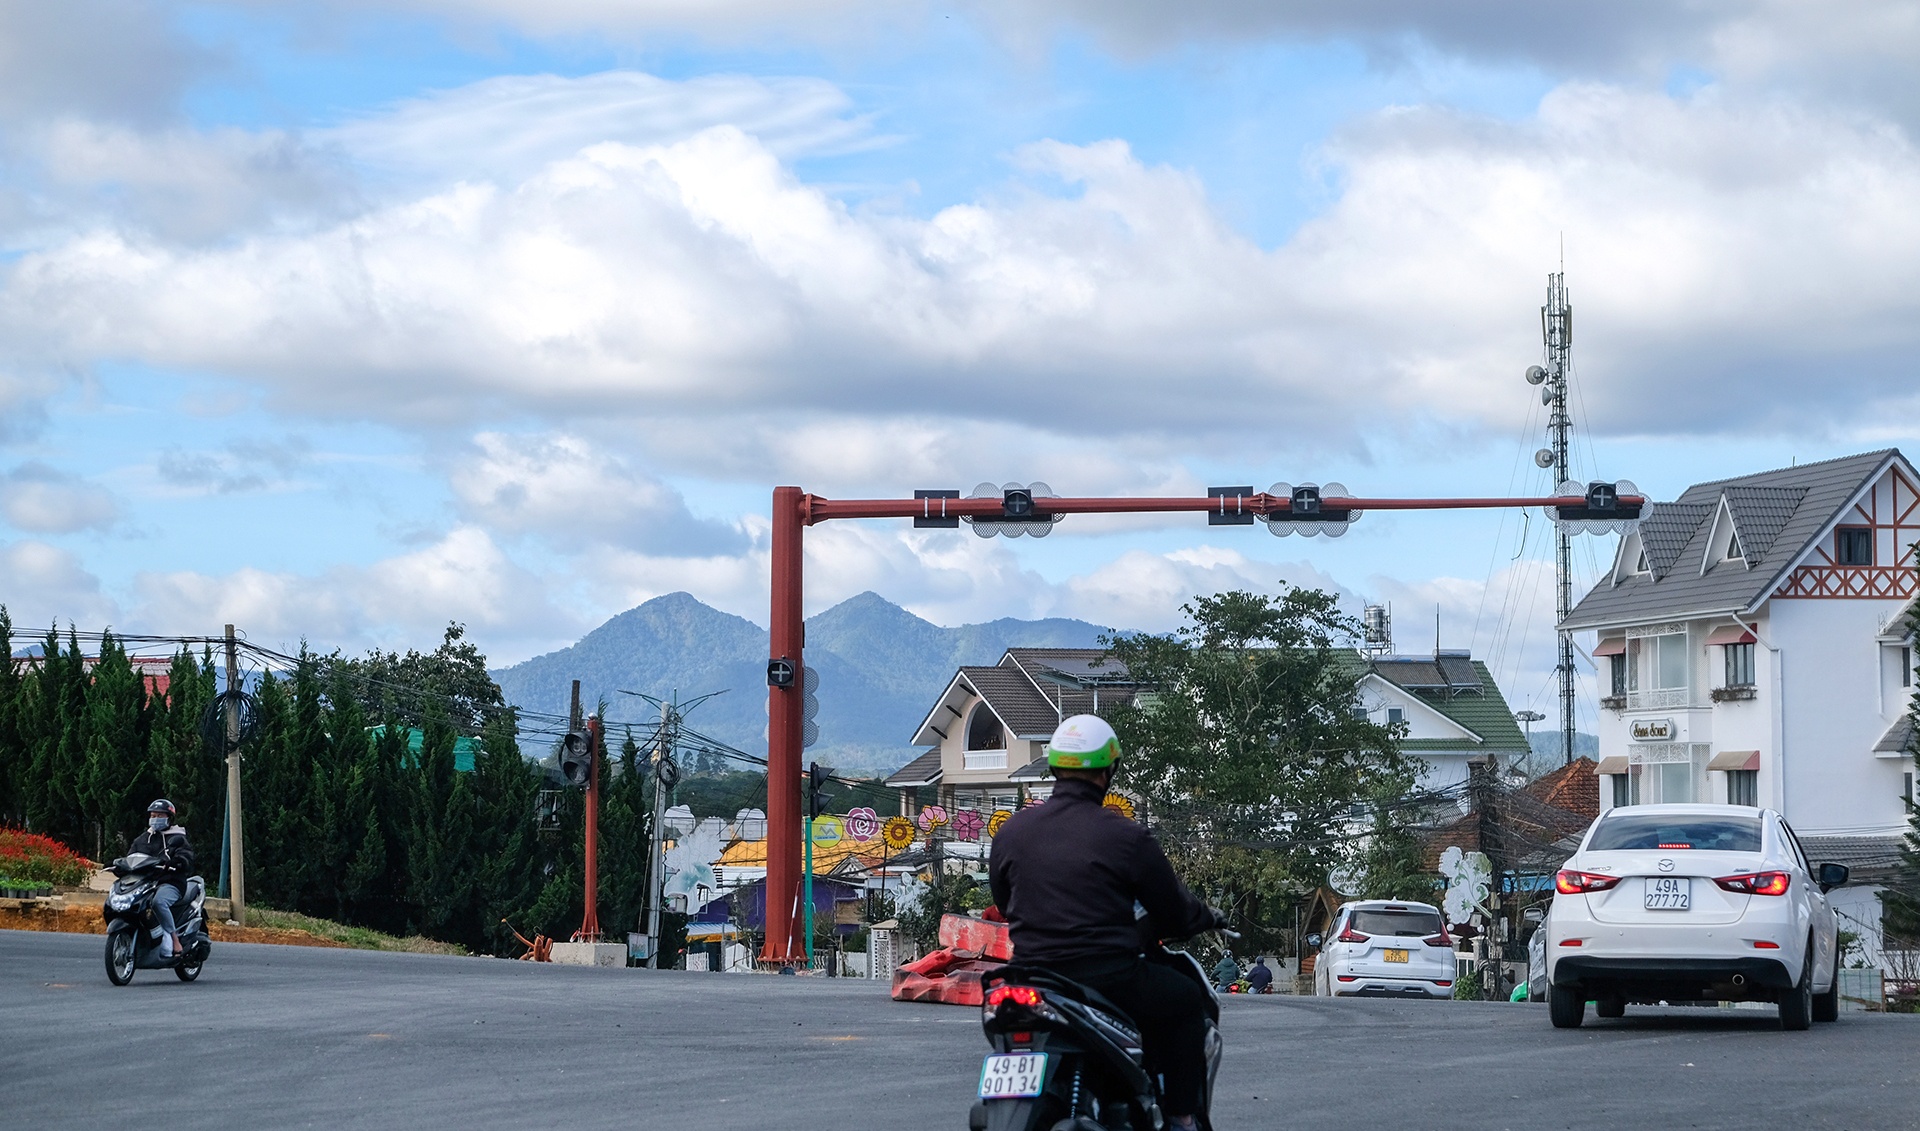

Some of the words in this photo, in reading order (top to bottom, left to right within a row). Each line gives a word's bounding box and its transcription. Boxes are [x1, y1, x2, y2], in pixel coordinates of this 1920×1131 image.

[1655, 879, 1679, 893] 49A
[1646, 893, 1688, 907] 277.72
[993, 1056, 1035, 1074] 49-B1
[983, 1075, 1037, 1094] 901.34
